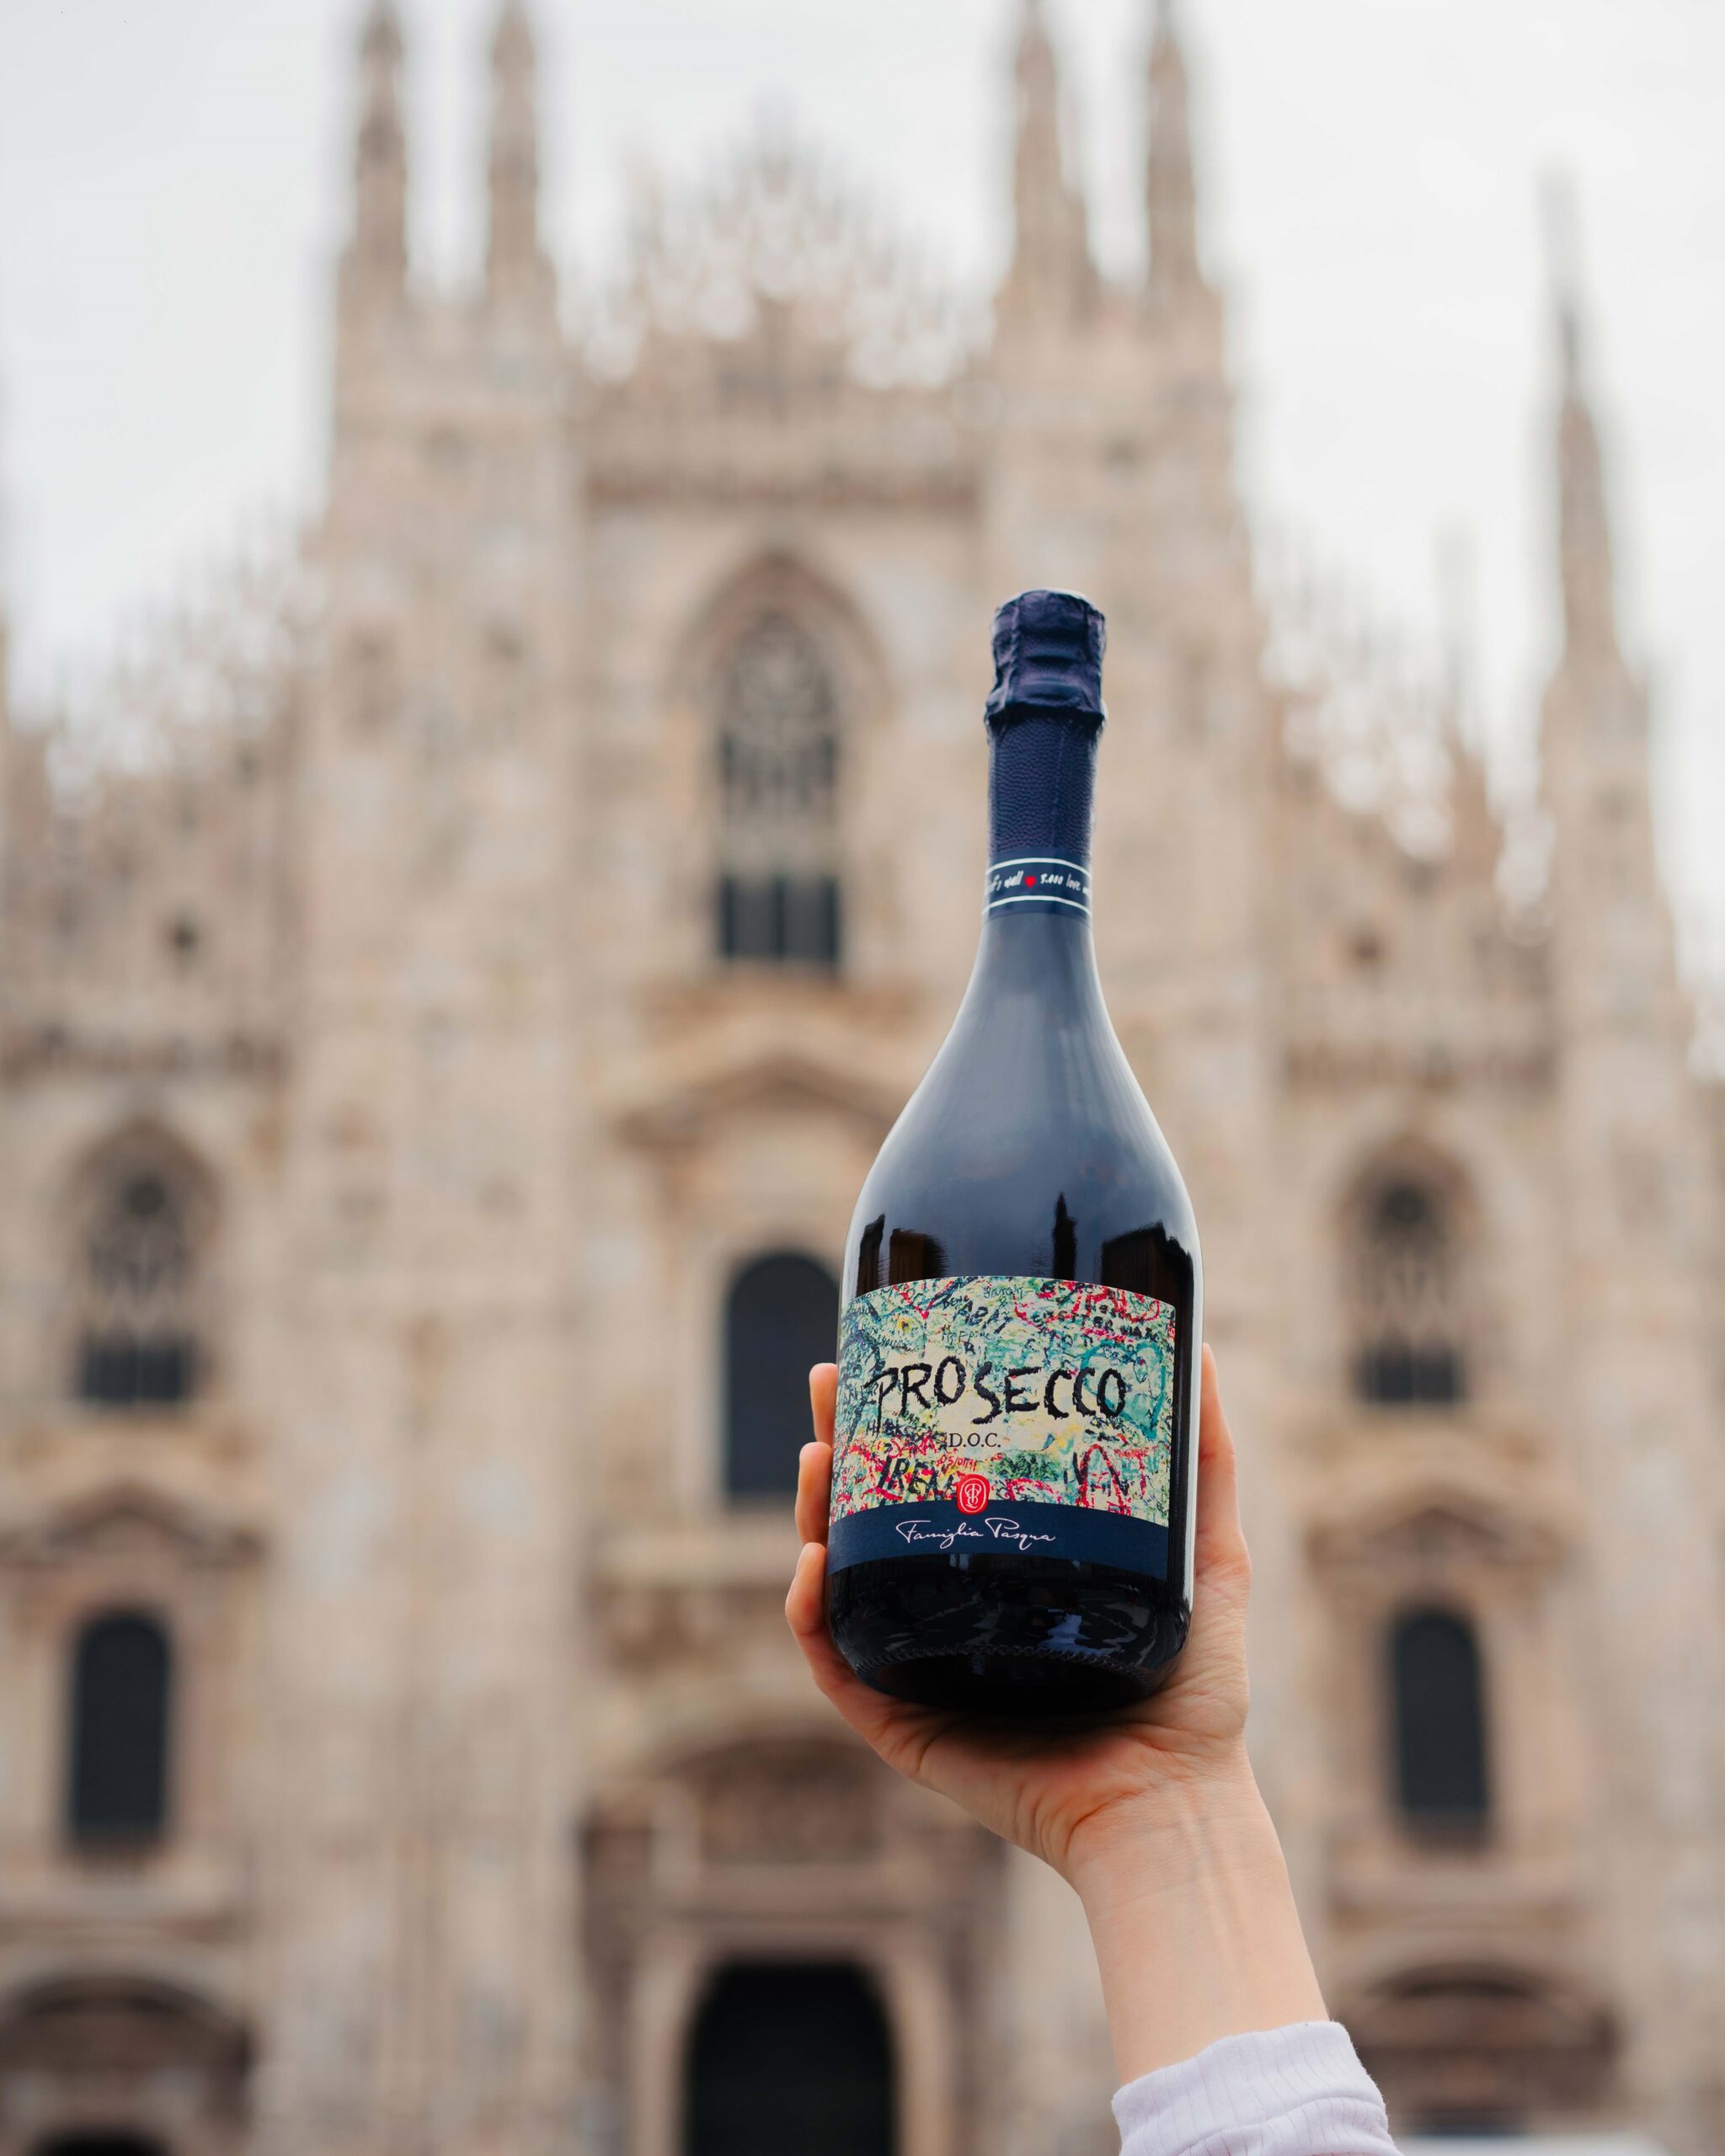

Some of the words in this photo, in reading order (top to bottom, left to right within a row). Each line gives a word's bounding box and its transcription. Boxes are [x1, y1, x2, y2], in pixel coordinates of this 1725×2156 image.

[863, 1354, 1127, 1433] PROSECCO
[948, 1432, 1001, 1448] D.O.C.
[895, 1519, 984, 1550] Famiglia
[985, 1517, 1056, 1550] Pasqua
